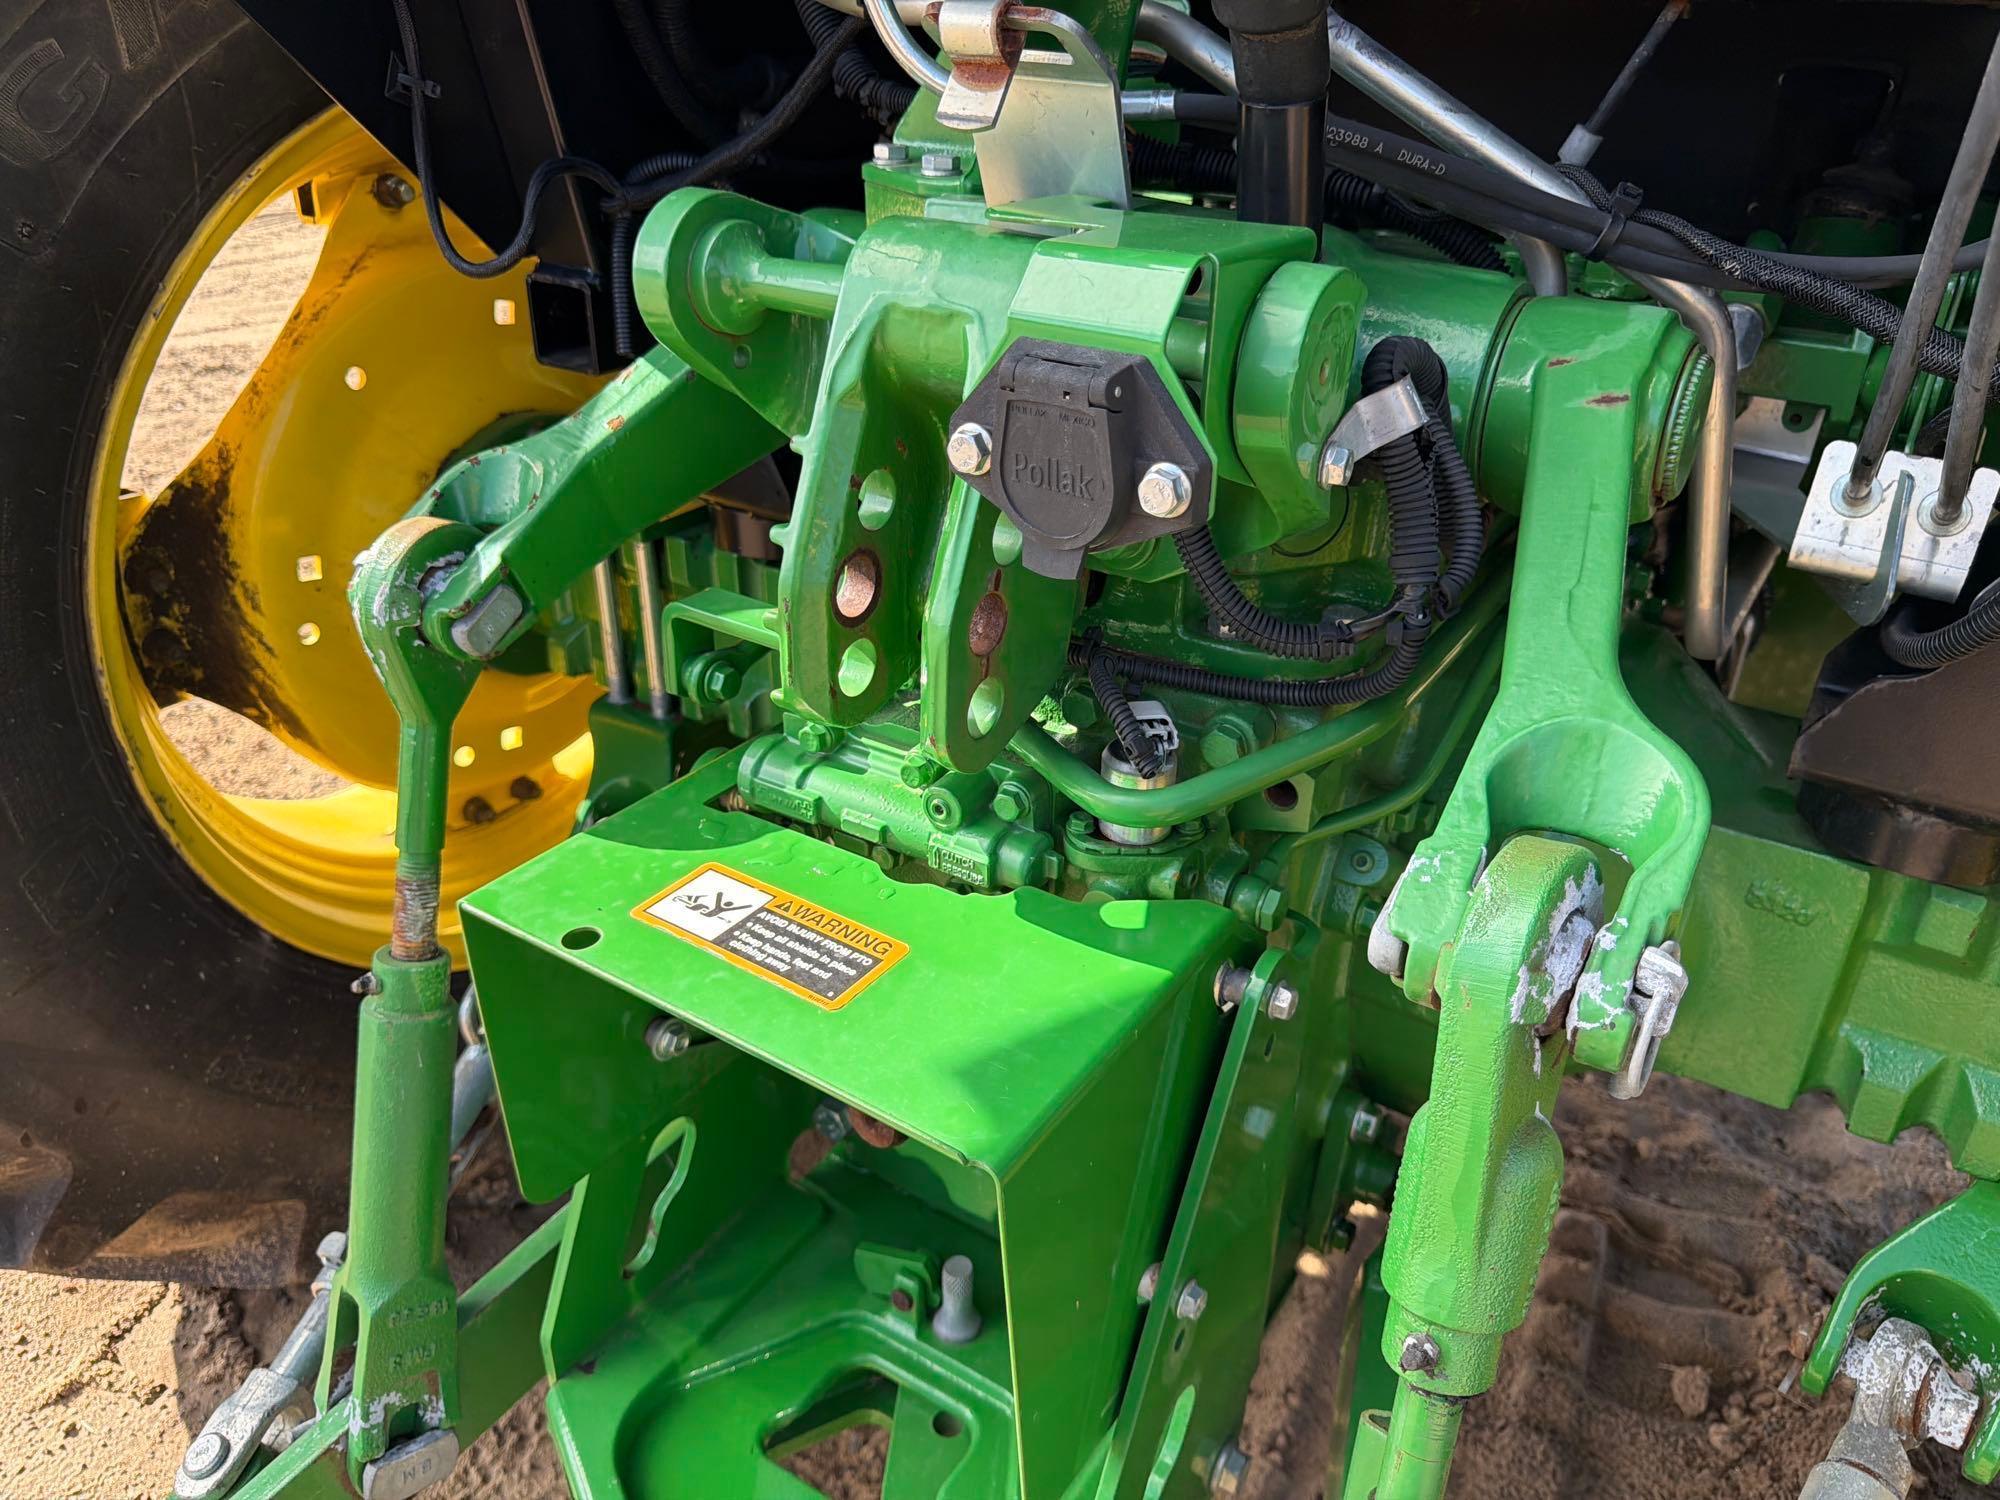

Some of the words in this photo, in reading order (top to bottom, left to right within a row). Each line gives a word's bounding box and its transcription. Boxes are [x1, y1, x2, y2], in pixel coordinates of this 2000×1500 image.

[1325, 125, 1369, 149] 23988
[1374, 142, 1384, 155] A
[1397, 148, 1446, 176] DURA-D
[1014, 452, 1095, 502] Pollak
[729, 940, 767, 961] clothing
[764, 957, 791, 972] away
[738, 932, 763, 948] Keep
[761, 943, 791, 963] hands,
[792, 957, 813, 971] feet
[810, 967, 833, 979] and
[751, 924, 776, 939] Keep
[774, 935, 790, 944] all
[786, 941, 820, 959] shields
[819, 954, 831, 964] in
[828, 961, 857, 976] place
[757, 911, 789, 928] AVOID
[786, 923, 824, 942] INJURY
[820, 939, 853, 957] FROM
[849, 952, 873, 966] PTO
[792, 905, 893, 956] WARNING
